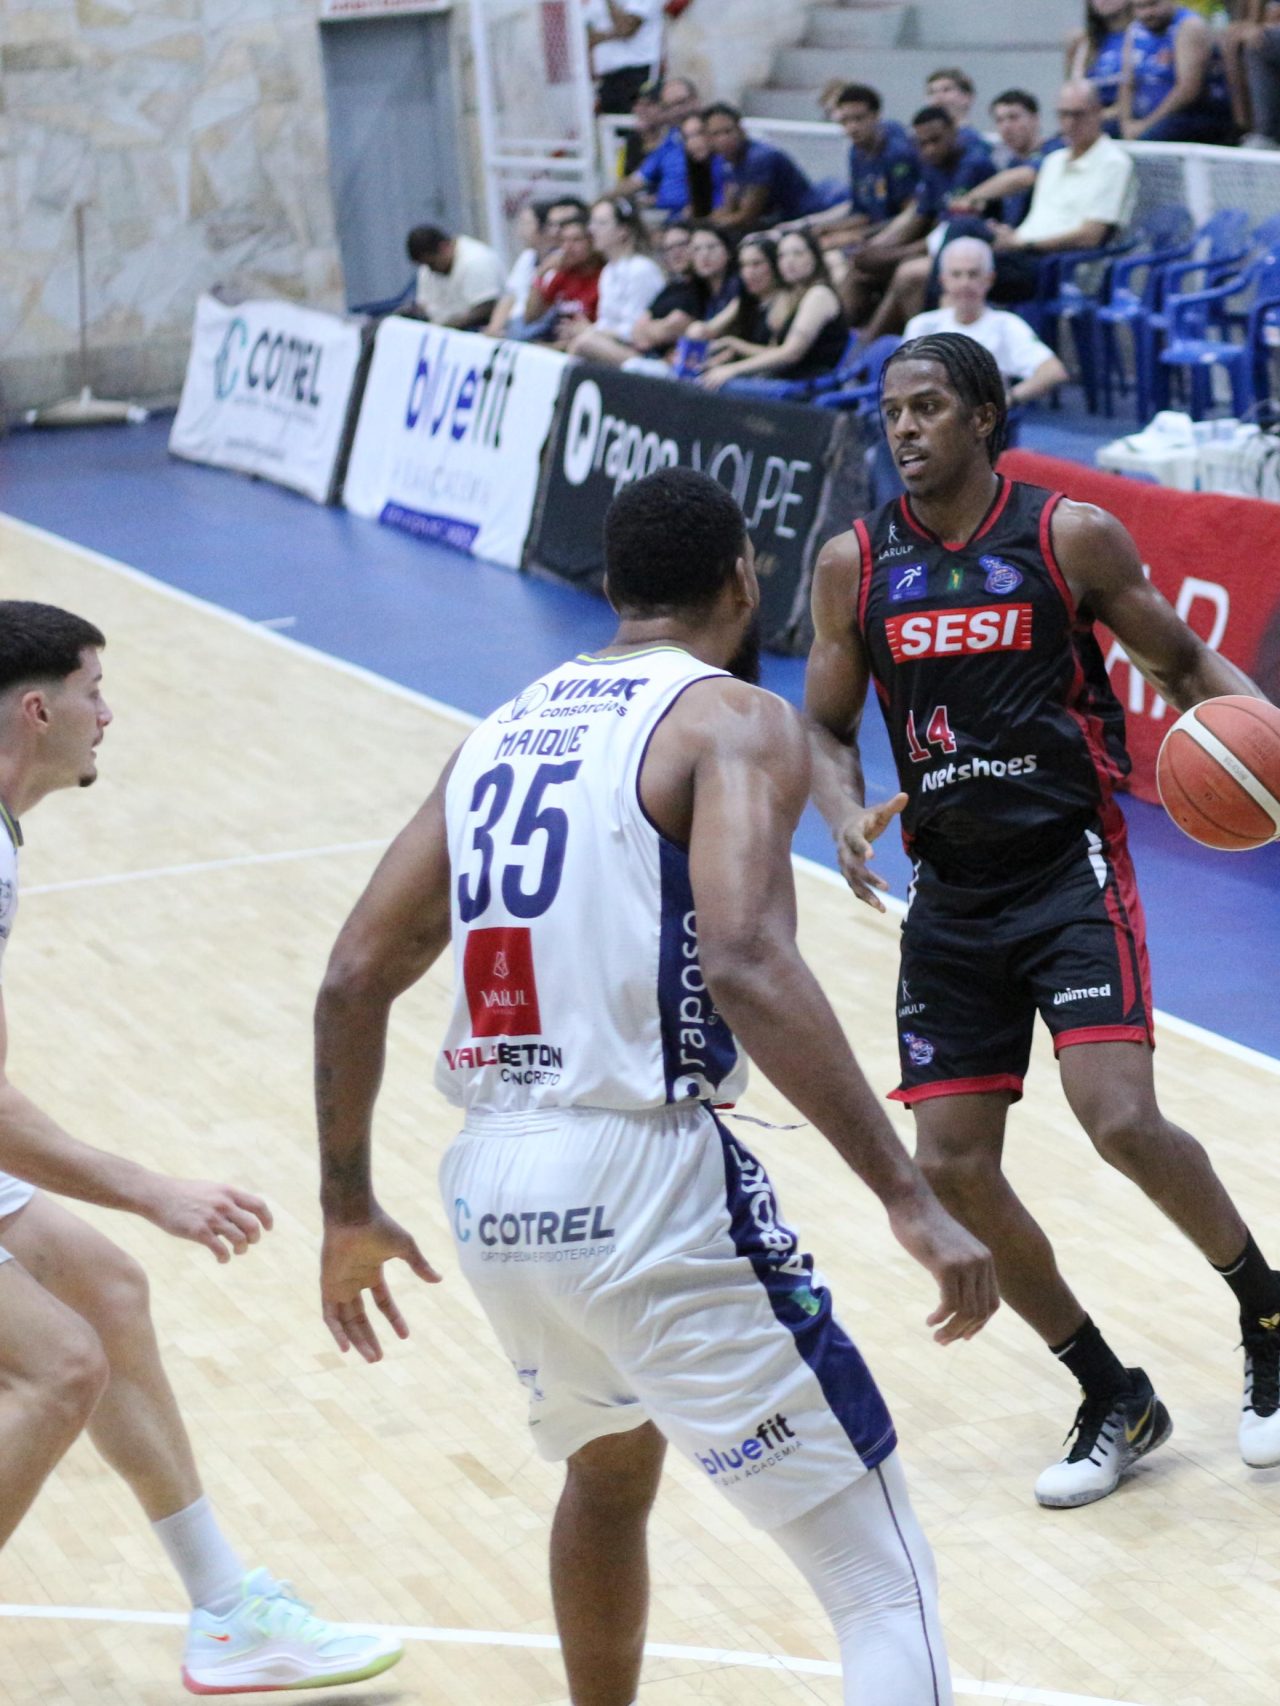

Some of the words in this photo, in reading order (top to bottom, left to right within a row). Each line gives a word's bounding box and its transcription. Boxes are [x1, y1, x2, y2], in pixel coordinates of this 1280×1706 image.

[405, 332, 519, 449] bluefit
[900, 608, 1019, 656] SESI
[550, 677, 650, 701] VINAC
[493, 724, 589, 761] MAIQUE
[905, 705, 957, 763] 14
[457, 759, 583, 922] 35
[1053, 983, 1111, 1005] Unimed
[478, 1205, 615, 1246] COTREL
[694, 1413, 796, 1475] bluefit
